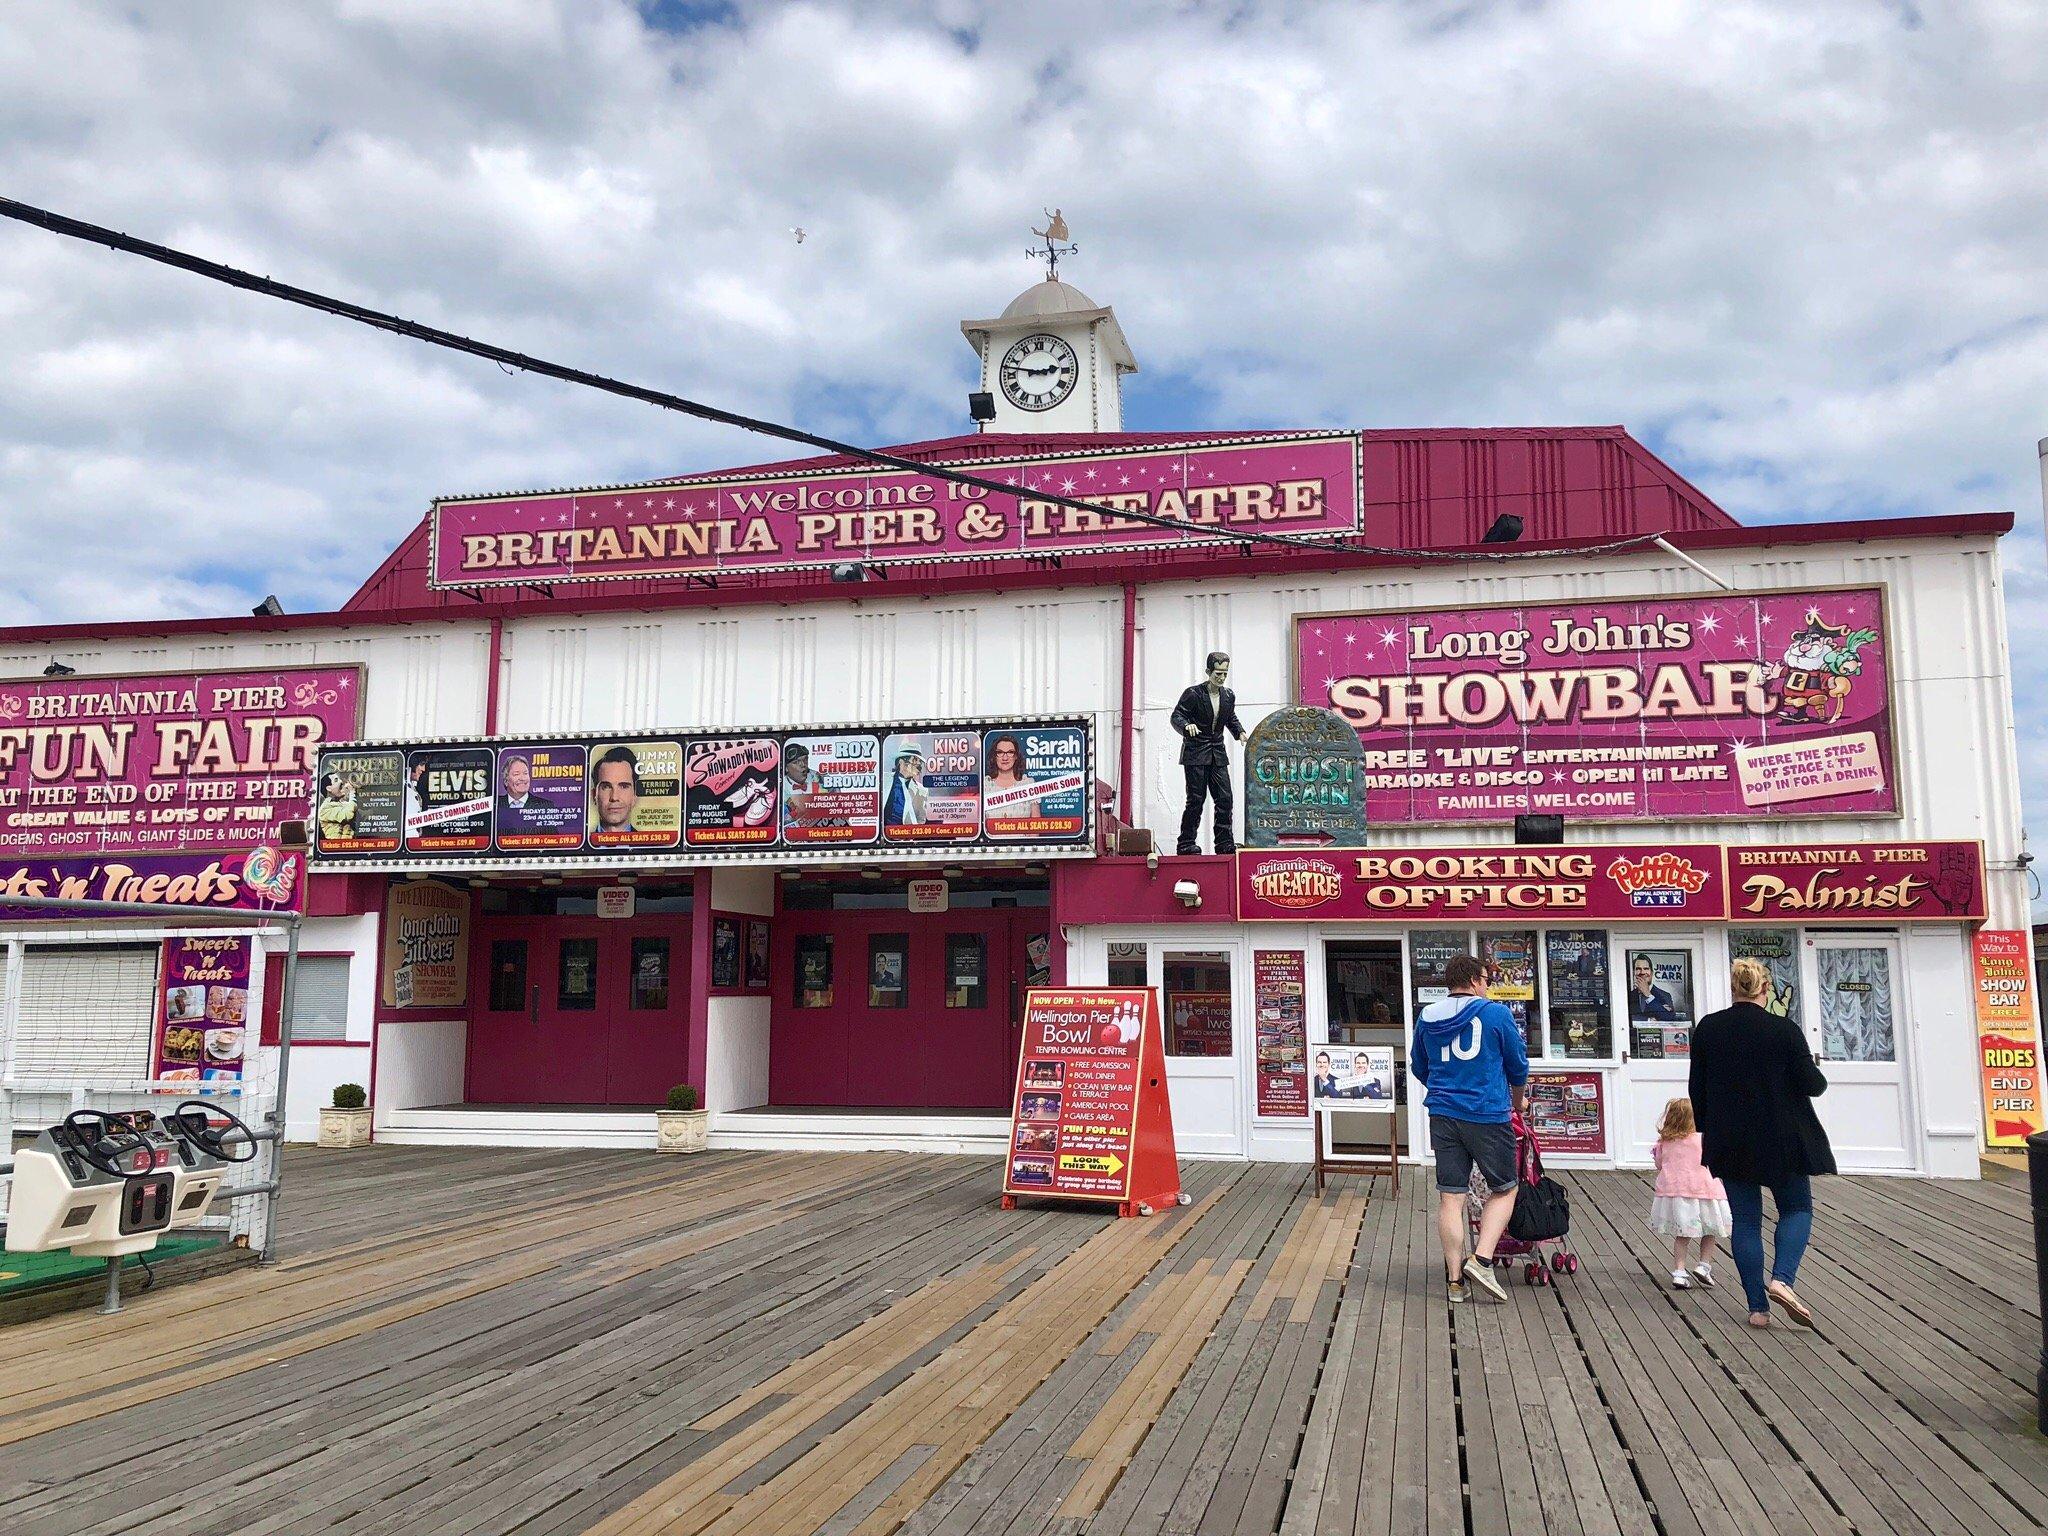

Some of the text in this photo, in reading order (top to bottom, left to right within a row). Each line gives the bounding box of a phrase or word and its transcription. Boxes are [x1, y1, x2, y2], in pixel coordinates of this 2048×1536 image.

[1026, 247, 1035, 259] N
[1072, 243, 1078, 254] S
[729, 481, 988, 514] Welcome to
[461, 479, 1323, 570] BRITANNIA PIER & THEATRE
[1410, 619, 1690, 662] Long John's
[27, 687, 286, 718] BRITANNIA PIER
[1332, 664, 1777, 728] SHOWBAR
[0, 716, 323, 779] FUN FAIR
[812, 742, 875, 759] LIVE ROY
[934, 738, 968, 754] KING
[1026, 735, 1080, 756] Sarah
[532, 754, 550, 766] JIM
[636, 751, 676, 761] JIMMY
[1026, 757, 1080, 769] MILLICAN
[1366, 749, 1427, 768] REE
[1526, 745, 1718, 763] ENTERTAINMENT
[1747, 743, 1866, 769] WHERE THE STARS
[329, 757, 399, 772] SUPREME
[532, 765, 583, 778] DAVIDSON
[635, 762, 677, 775] CARR
[819, 761, 877, 774] CHUBBY
[927, 757, 976, 772] OF POP
[1256, 756, 1357, 782] GHOST
[1763, 757, 1853, 778] OF STAGE & TV
[349, 772, 398, 787] QUEEN
[429, 770, 487, 792] ELVIS
[823, 775, 876, 788] BROWN
[1366, 766, 1728, 788] ARAOKE & DISCO OPEN til LATE
[1746, 766, 1878, 794] POP IN FOR A DRINK
[29, 780, 306, 806] THE END OF THE PIER
[429, 792, 486, 801] WORLD TOUR
[987, 777, 1081, 806] NEW DATES COMING SOON
[1265, 783, 1349, 805] TRAIN
[1438, 792, 1635, 809] FAMILIES WELCOME
[7, 806, 273, 827] GREAT VALUE & LOTS OF FUN
[408, 801, 490, 826] NEW DATES COMING SOON
[1030, 821, 1049, 830] SEATS
[0, 832, 45, 846] DGEMS,
[49, 830, 92, 845] GHOST
[95, 829, 134, 844] TRAIN,
[138, 828, 174, 842] GIANT
[177, 828, 214, 841] SLIDE
[217, 829, 225, 840] &
[228, 827, 266, 840] MUCH
[728, 831, 746, 839] SEATS
[1740, 849, 1928, 865] BRITANNIA PIER
[1259, 860, 1334, 874] Britannia Pier
[1355, 855, 1596, 879] BOOKING
[1611, 855, 1704, 892] Pettitts
[102, 862, 240, 902] Treats
[1253, 868, 1340, 897] THEATRE
[603, 891, 630, 899] VIDEO
[1367, 884, 1585, 907] OFFICE
[1741, 869, 1928, 911] Palmist
[1633, 895, 1683, 905] PARK
[427, 912, 460, 935] John
[182, 937, 240, 951] Sweets
[1568, 933, 1584, 941] JIM
[1741, 935, 1783, 946] Romany
[1988, 935, 2010, 943] This
[1551, 942, 1602, 950] DAVIDSON
[1980, 944, 2019, 953] Way to
[1654, 964, 1682, 972] JIMMY
[1980, 956, 2014, 967] Long
[184, 966, 233, 981] Treats
[416, 965, 456, 978] SHOWBAR
[1654, 972, 1683, 980] CARR
[1839, 983, 1871, 991] CLOSED
[1980, 979, 2026, 992] SHOW
[1033, 997, 1096, 1005] NOW OPEN The
[1989, 993, 2019, 1006] BAR
[1030, 1010, 1112, 1026] Wellington Pier
[1042, 1024, 1092, 1044] Bowl
[1035, 1046, 1128, 1056] TENPIN BOWLING CENTRE
[1985, 1049, 2034, 1068] RIDES
[1095, 1072, 1116, 1080] DINER
[1073, 1083, 1099, 1091] OCEAN
[1100, 1083, 1117, 1091] VIEW
[1990, 1078, 2033, 1090] END
[1079, 1091, 1109, 1099] TERRACE
[1071, 1102, 1130, 1111] AMERICAN POOL
[1993, 1099, 2033, 1111] PIER
[1070, 1113, 1115, 1121] GAMES AREA
[1063, 1125, 1129, 1136] FUN FOR ALL
